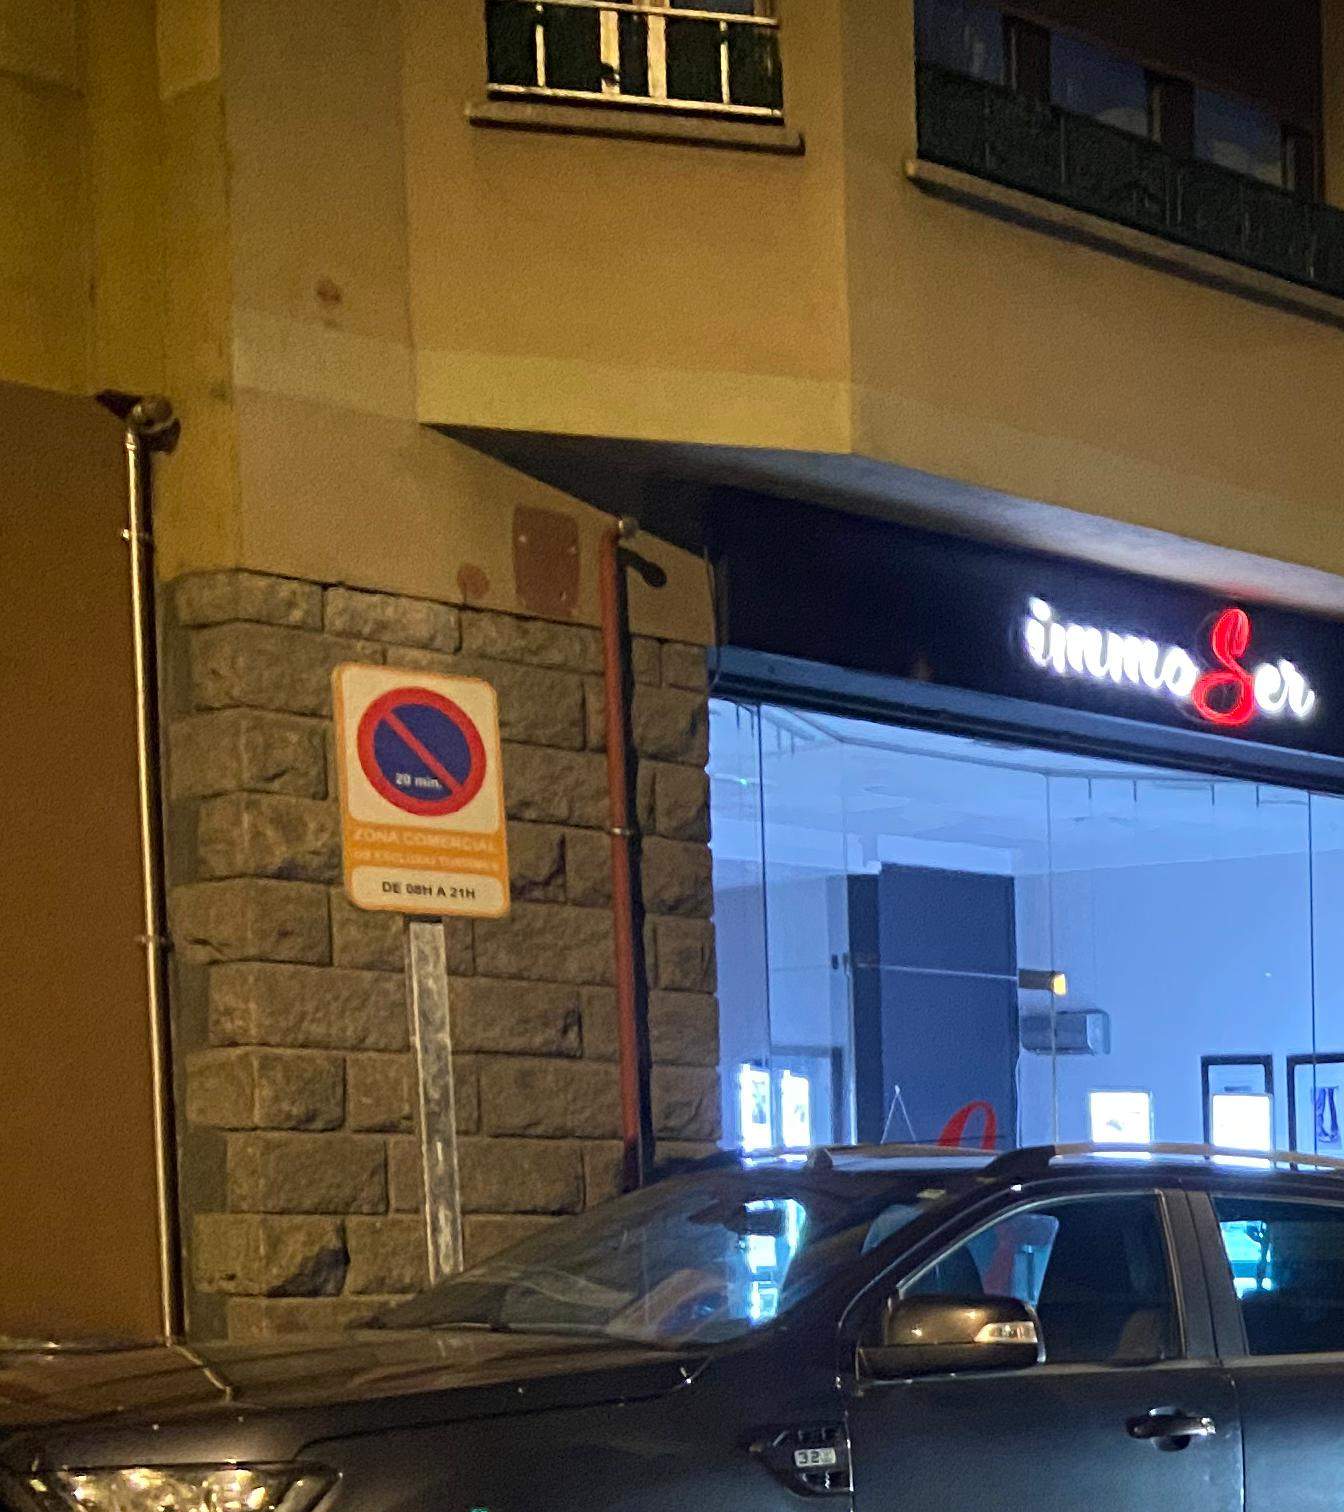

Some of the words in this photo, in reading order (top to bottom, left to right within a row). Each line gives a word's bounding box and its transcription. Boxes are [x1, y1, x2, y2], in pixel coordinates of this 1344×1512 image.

[395, 772, 412, 788] 20
[382, 881, 401, 894] DE
[436, 886, 447, 897] A
[450, 887, 476, 899] 21H
